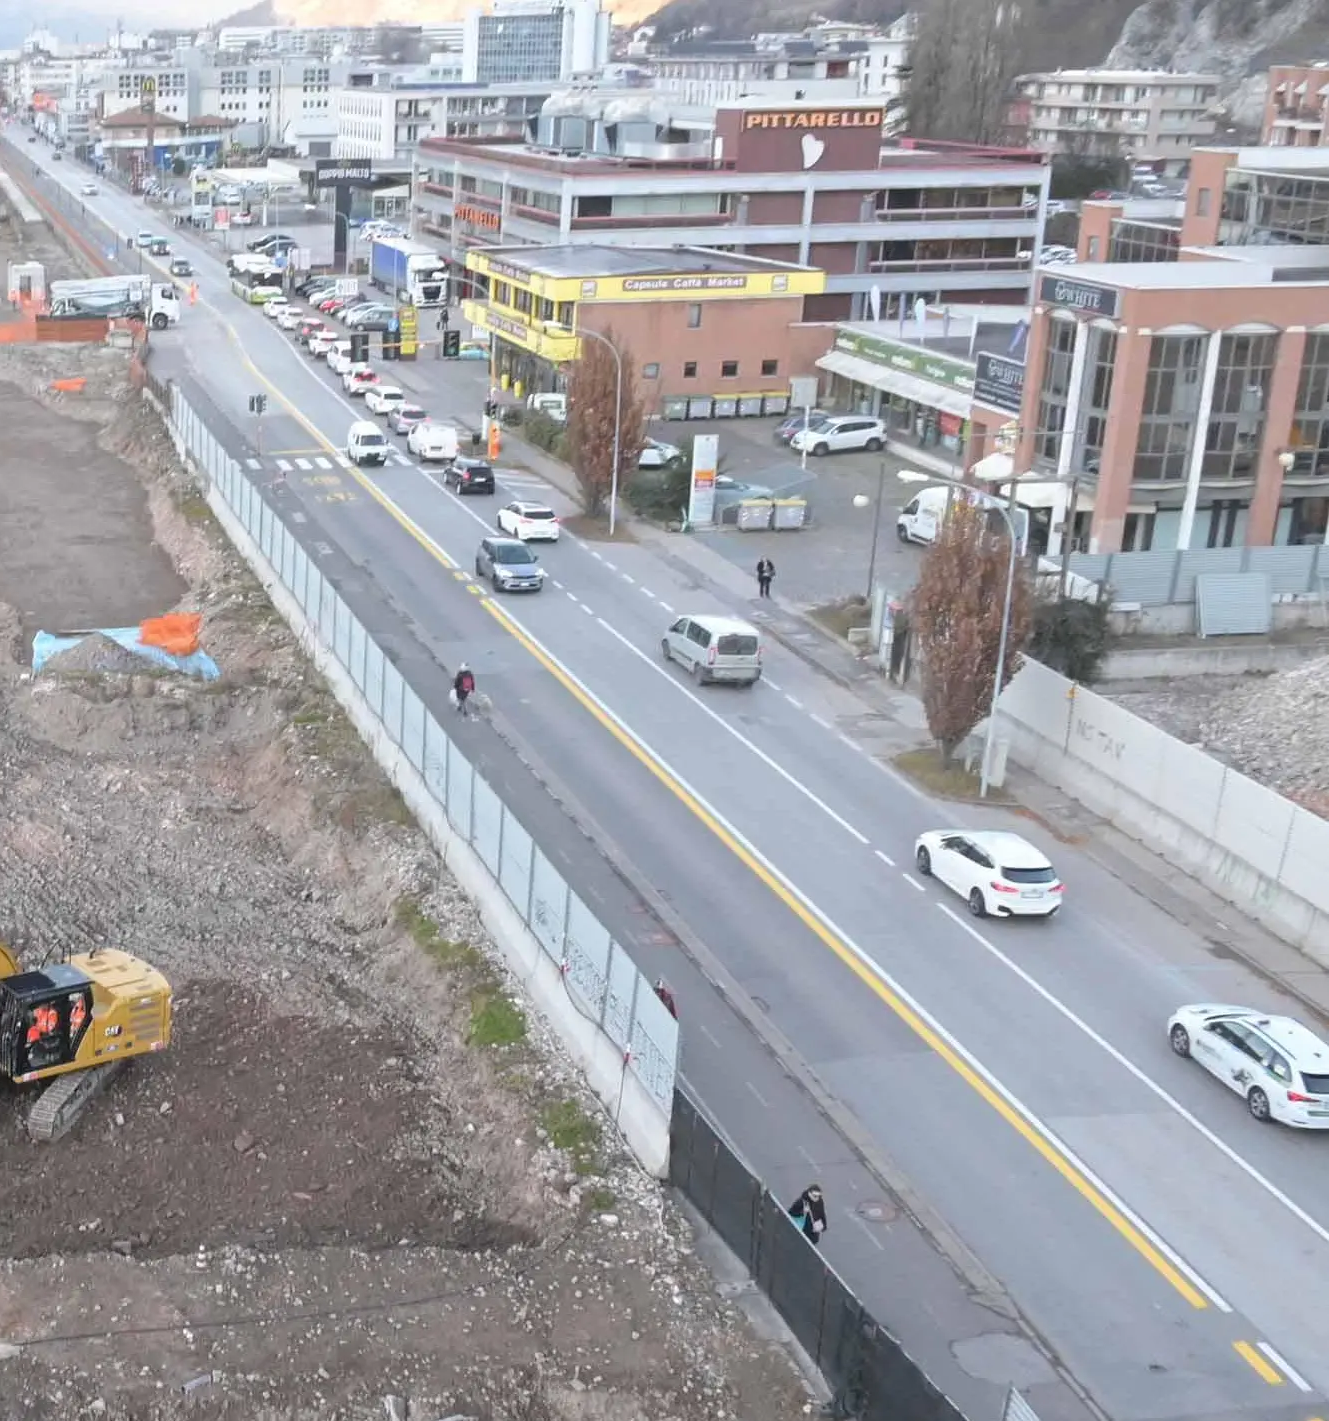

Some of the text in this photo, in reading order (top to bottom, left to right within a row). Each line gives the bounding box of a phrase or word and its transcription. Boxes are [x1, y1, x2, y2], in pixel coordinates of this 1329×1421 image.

[746, 111, 881, 129] PITTARELLO
[346, 168, 369, 179] MALTO
[625, 279, 669, 291] Capsule
[707, 276, 744, 287] Market
[105, 1025, 120, 1037] CAT
